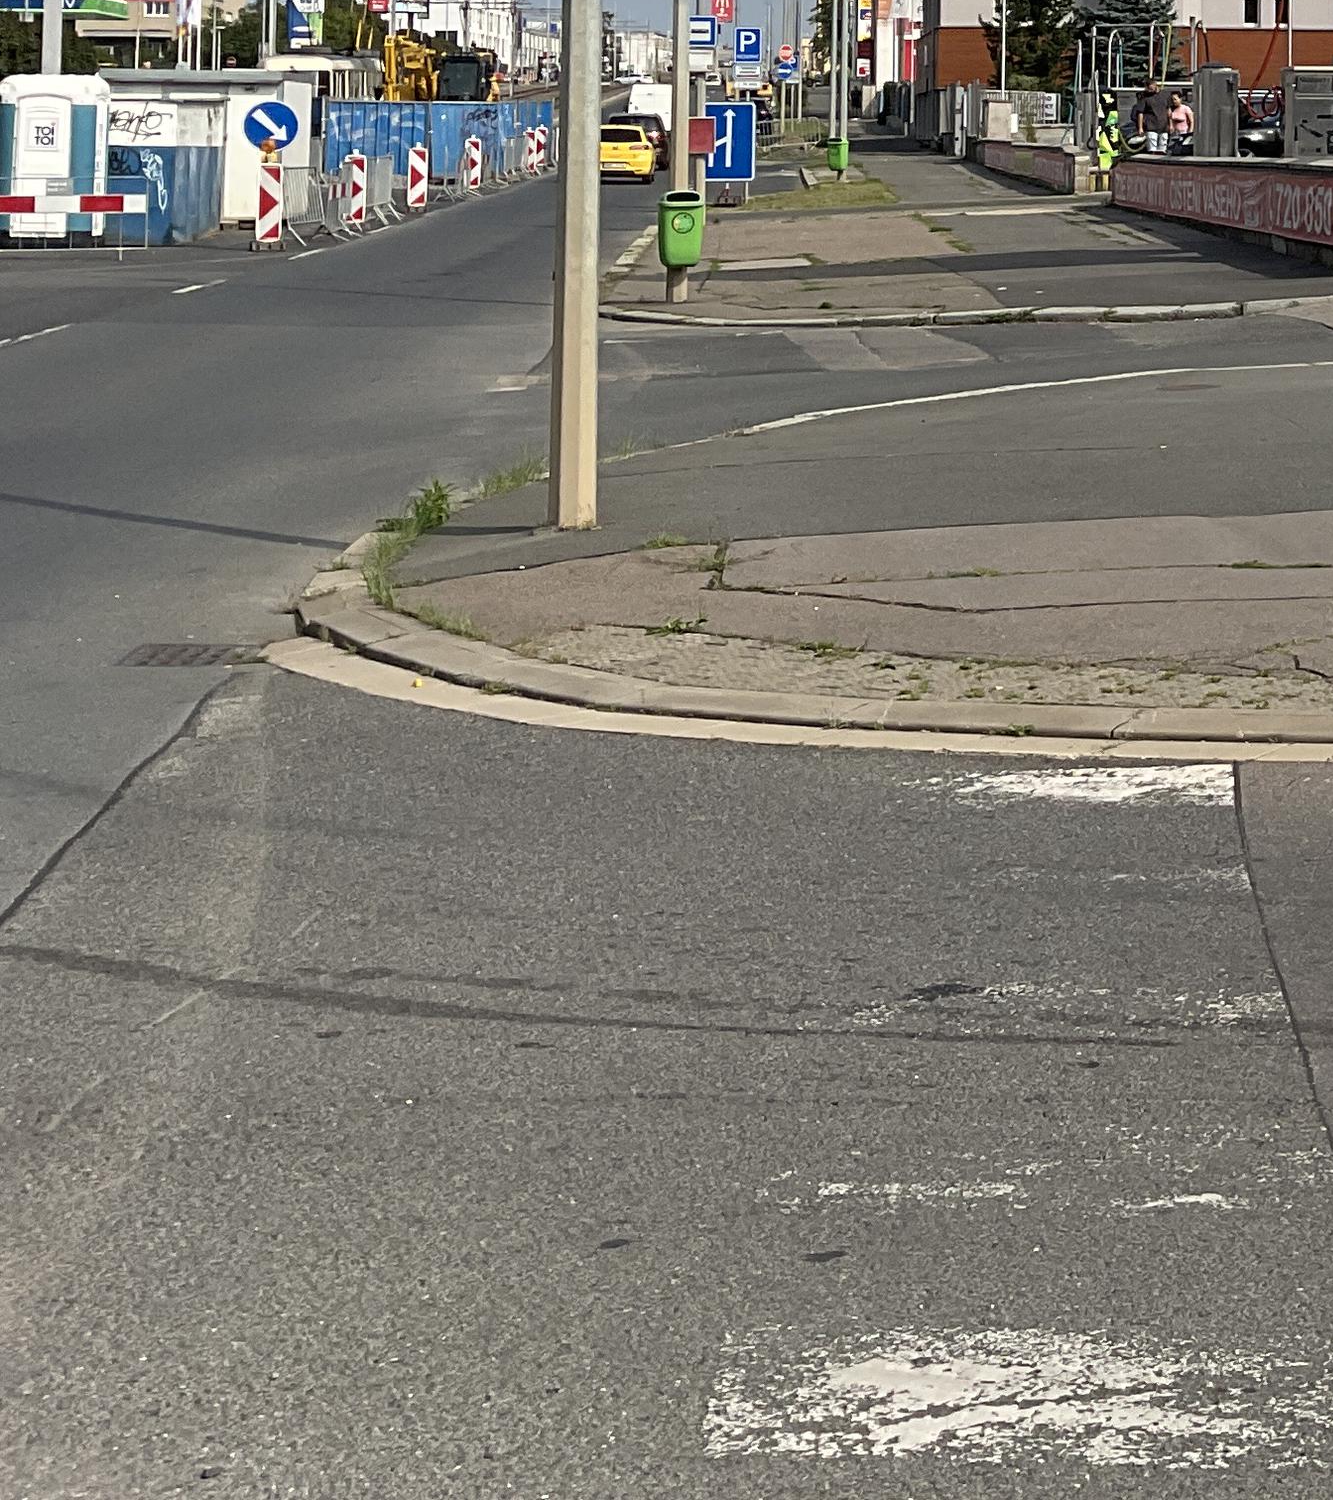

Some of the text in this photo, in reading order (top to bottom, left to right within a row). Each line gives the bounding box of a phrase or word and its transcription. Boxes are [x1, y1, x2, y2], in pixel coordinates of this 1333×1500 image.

[739, 31, 757, 52] P
[1275, 182, 1300, 230] 720
[1304, 185, 1333, 236] 850
